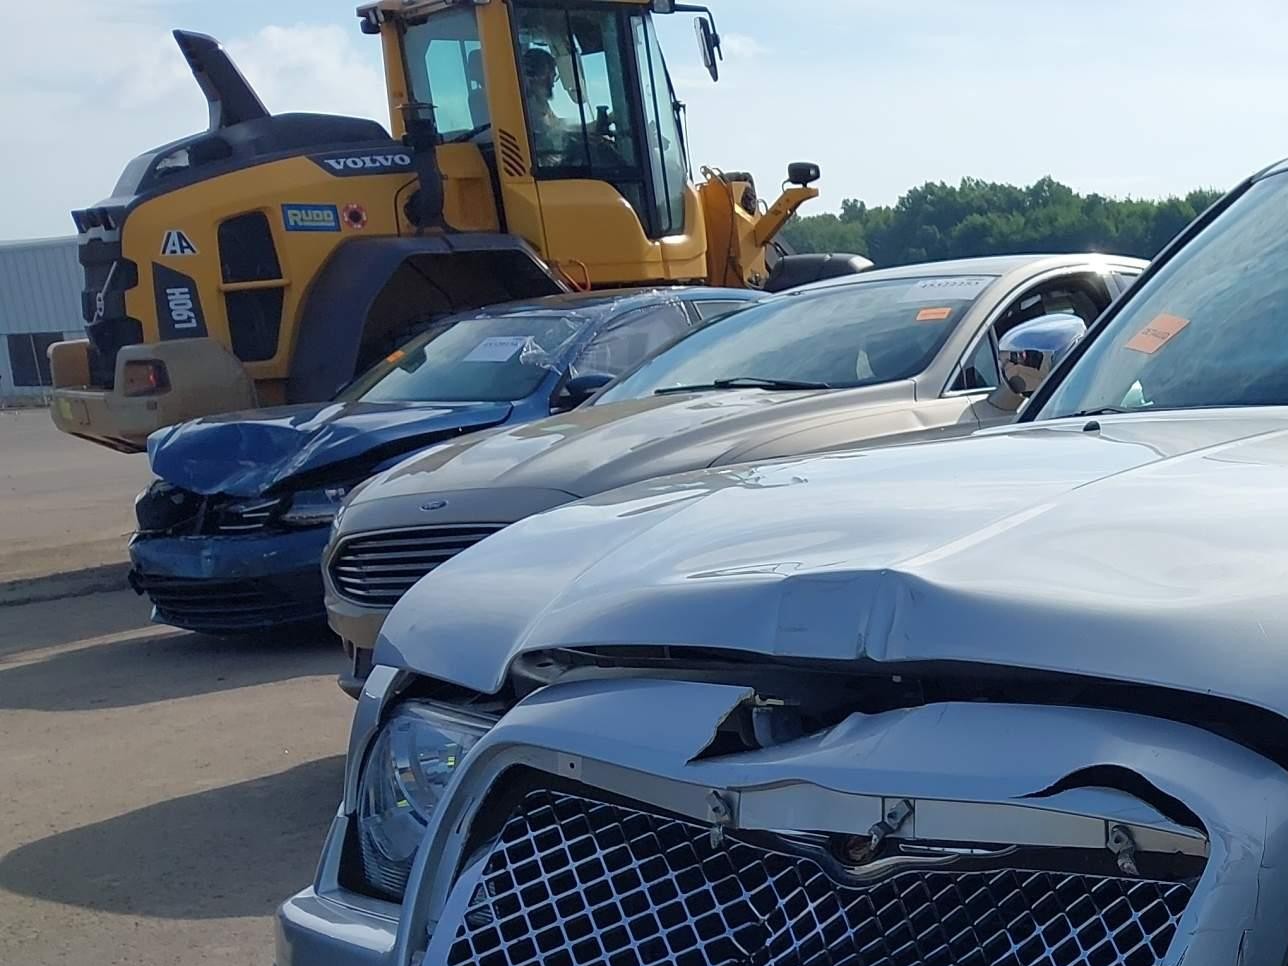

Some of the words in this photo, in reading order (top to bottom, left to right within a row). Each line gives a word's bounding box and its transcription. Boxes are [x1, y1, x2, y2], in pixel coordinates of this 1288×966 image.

[324, 154, 411, 169] VOLVO
[287, 210, 334, 226] RUDD
[166, 287, 197, 329] L90H
